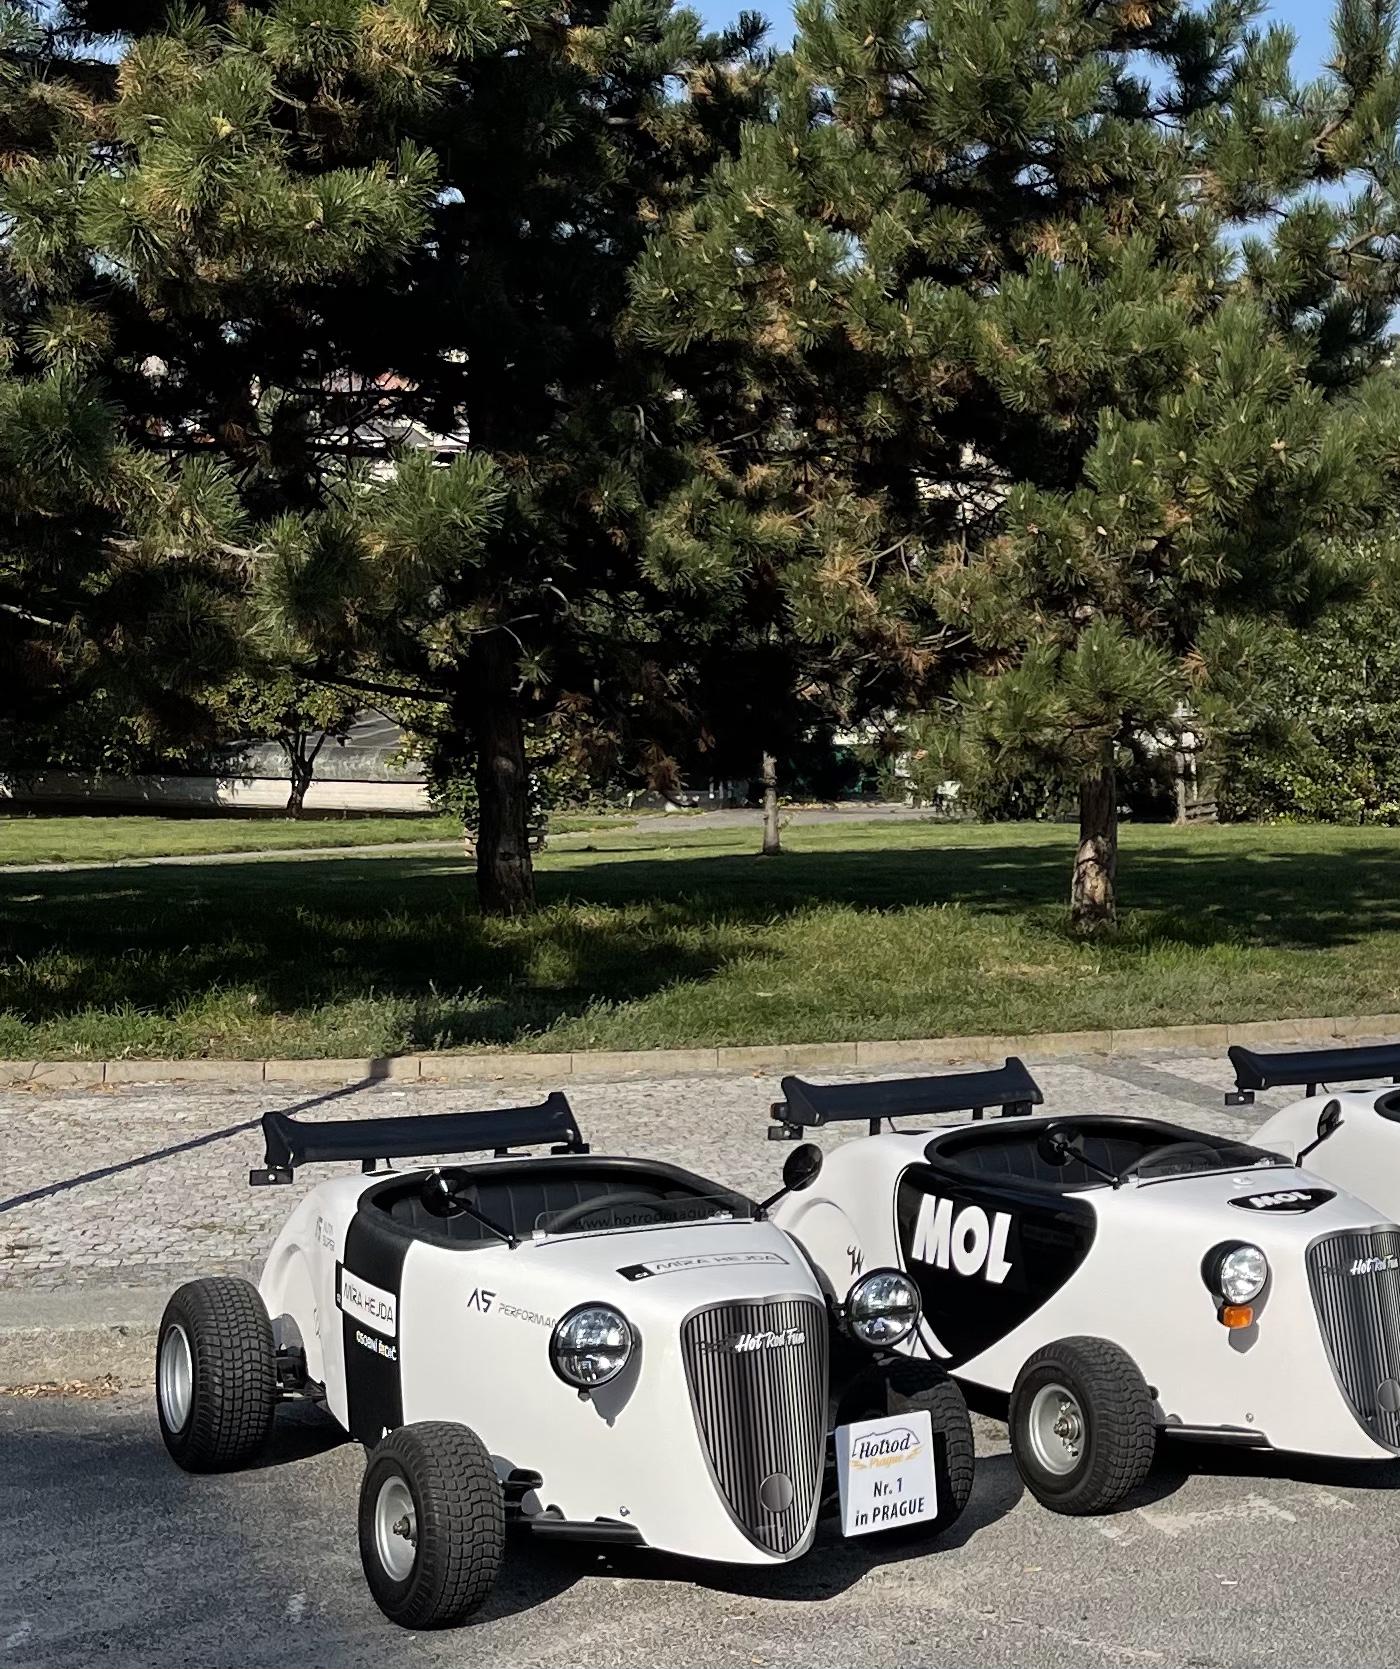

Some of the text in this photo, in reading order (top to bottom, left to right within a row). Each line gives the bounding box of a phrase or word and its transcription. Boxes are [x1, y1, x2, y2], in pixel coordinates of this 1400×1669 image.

[1249, 1191, 1311, 1209] MOL
[912, 1193, 1012, 1284] MOL
[1350, 1258, 1372, 1275] Hot
[735, 1333, 767, 1353] Hot
[859, 1433, 911, 1460] Hotrod
[873, 1477, 903, 1498] Nr. 1
[855, 1497, 925, 1528] in PRAGUE
